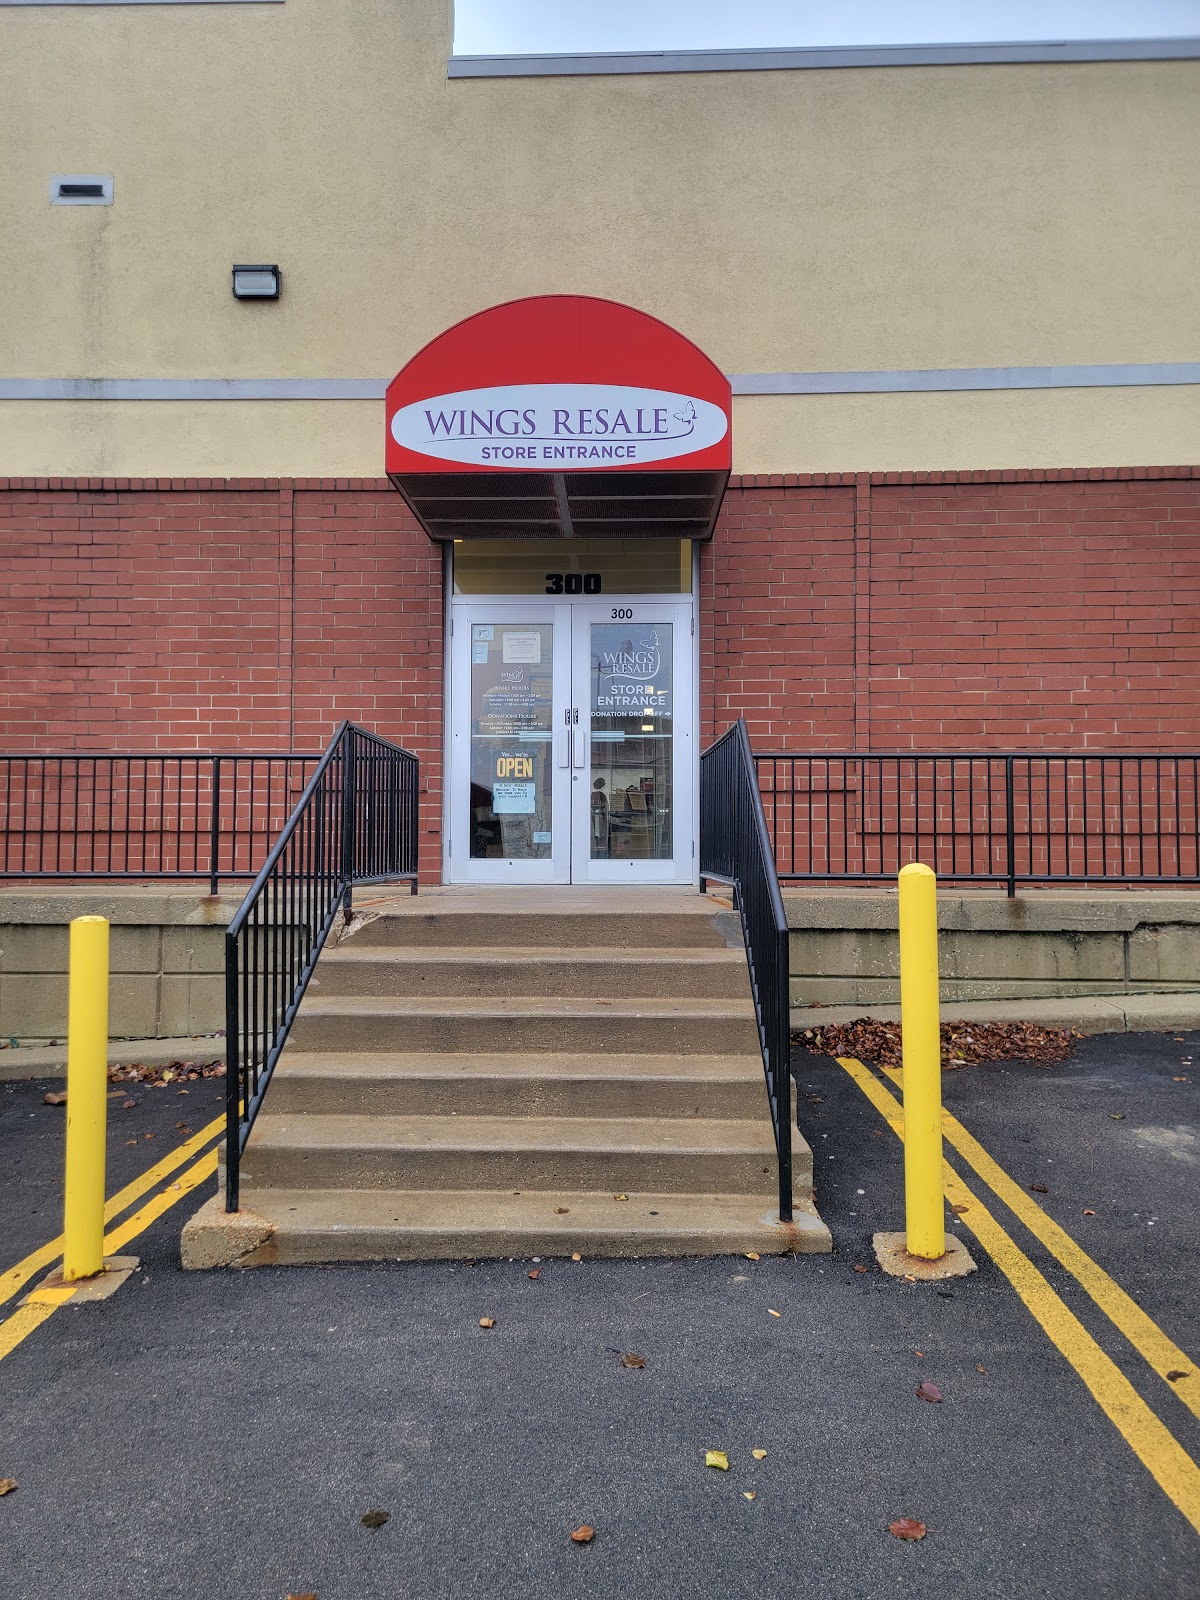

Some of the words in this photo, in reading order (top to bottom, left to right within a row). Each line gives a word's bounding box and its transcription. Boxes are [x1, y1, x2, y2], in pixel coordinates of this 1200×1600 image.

[424, 409, 536, 436] WINGS
[552, 408, 668, 435] RESALE
[481, 446, 537, 459] STORE
[543, 445, 636, 459] ENTRANCE
[545, 573, 601, 594] 300
[611, 608, 633, 619] 300
[603, 651, 654, 664] WINGS
[612, 663, 655, 674] RESALE
[610, 685, 654, 695] STORE
[597, 696, 666, 706] ENTRANCE
[496, 757, 533, 778] OPEN
